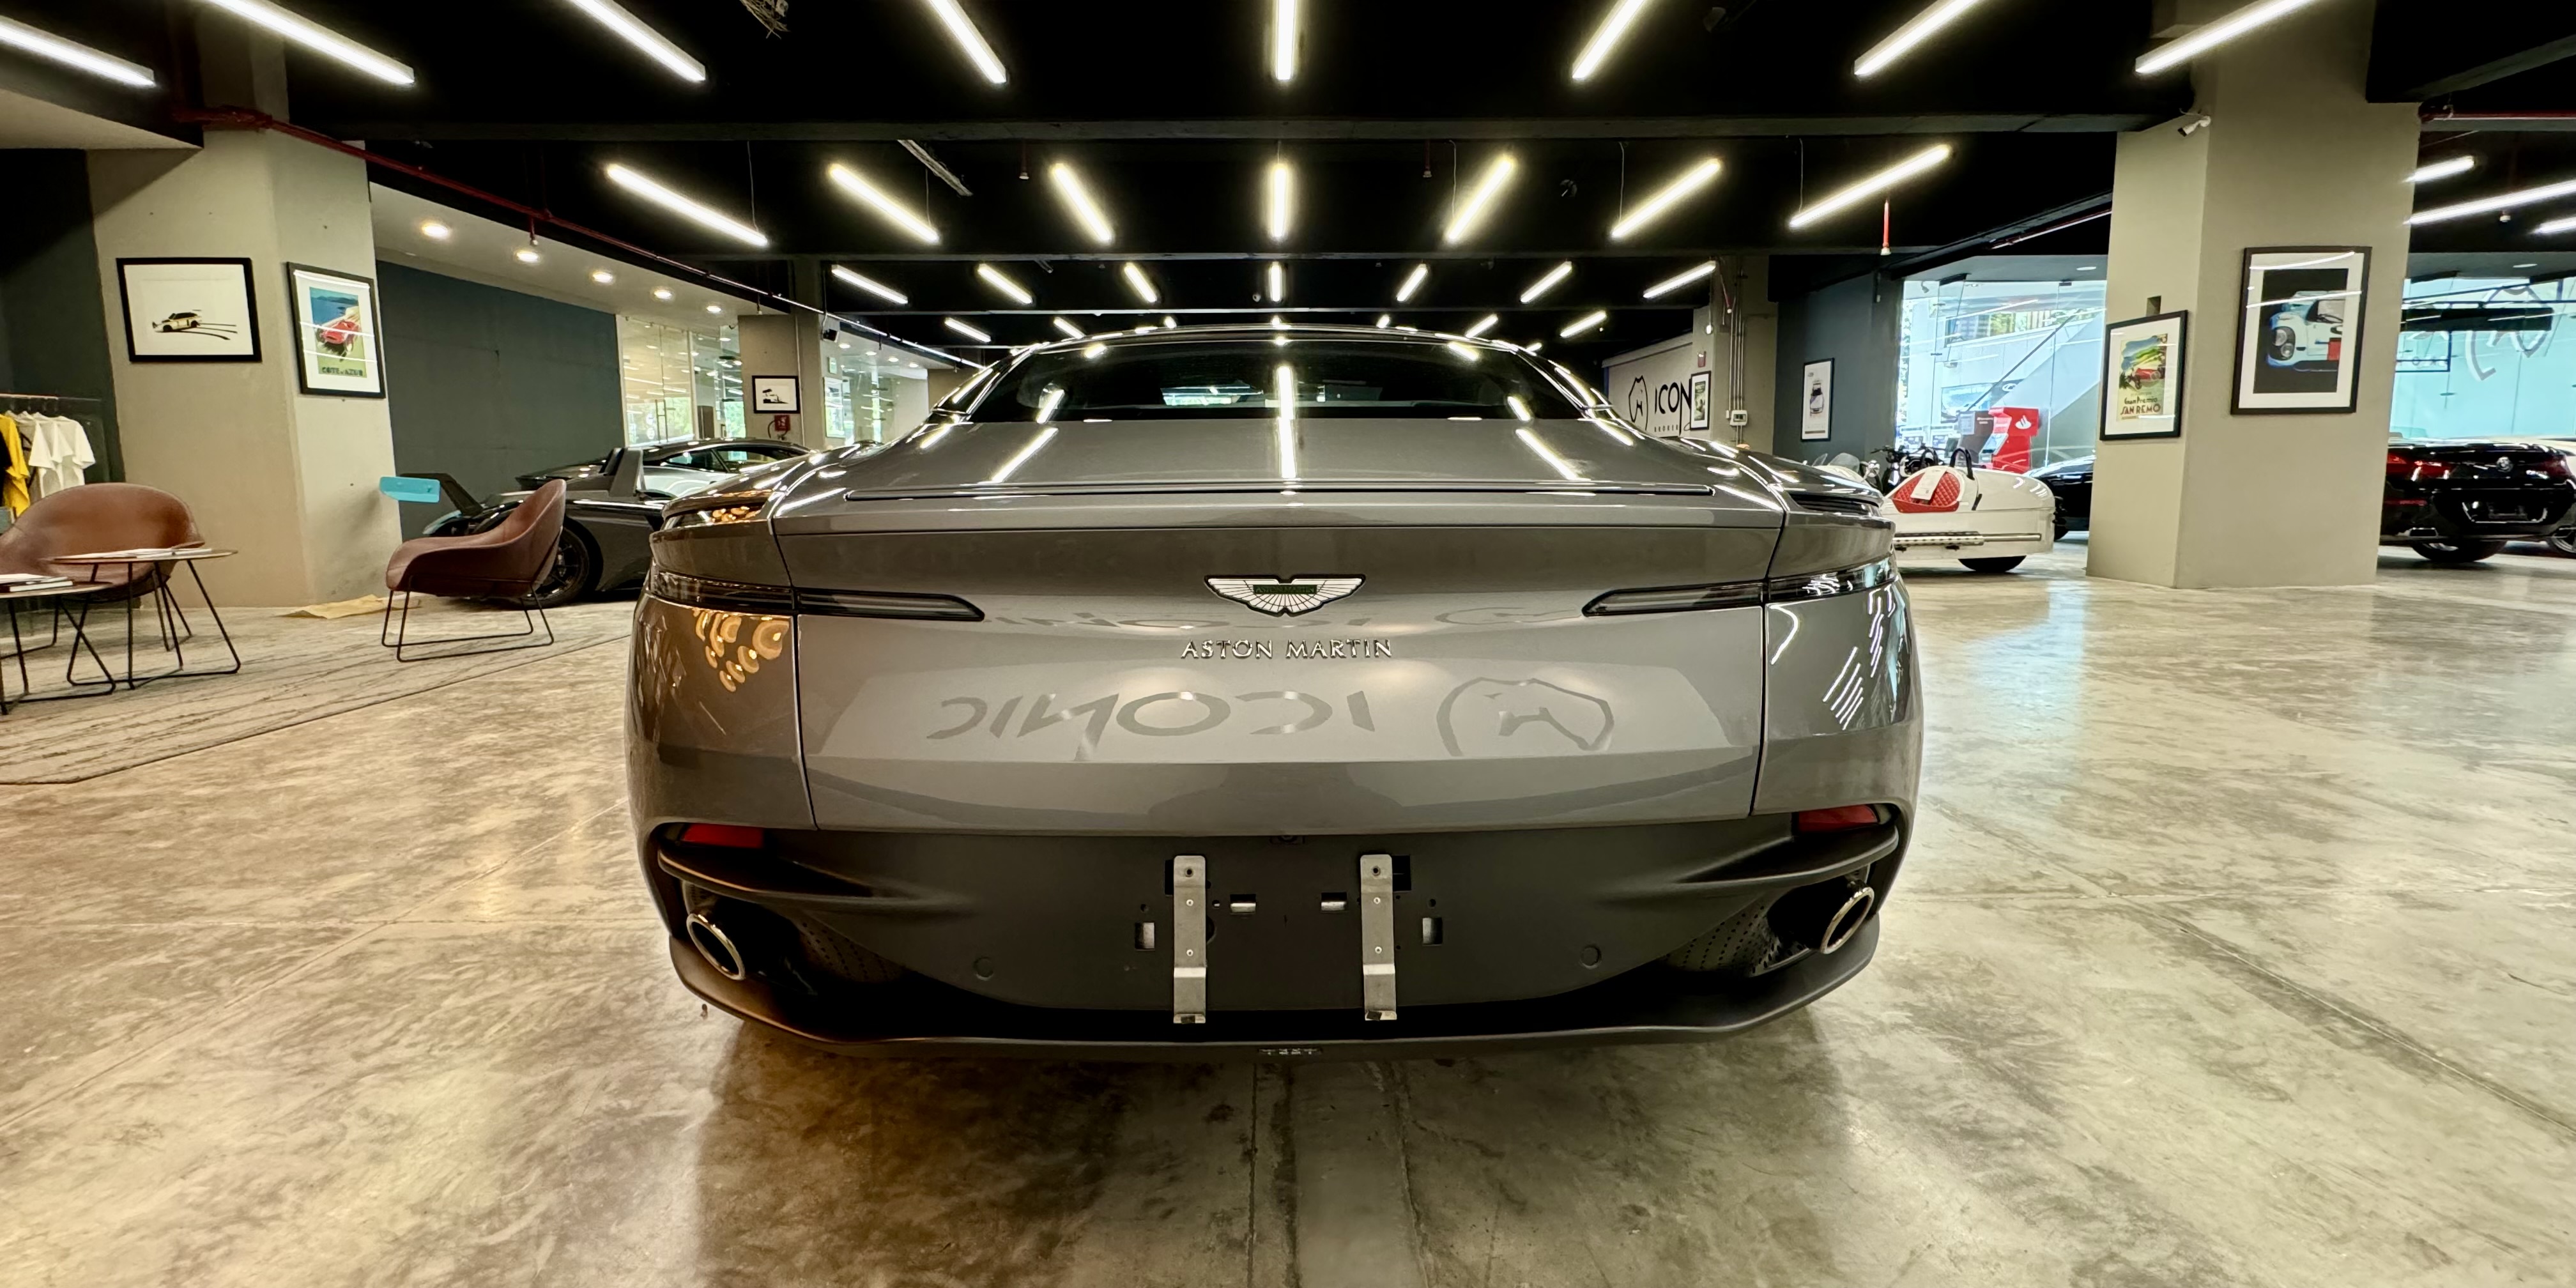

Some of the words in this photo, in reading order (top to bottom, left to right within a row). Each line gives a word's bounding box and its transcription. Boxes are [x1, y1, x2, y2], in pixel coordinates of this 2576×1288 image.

[2120, 406, 2135, 415] SAN
[2136, 403, 2161, 415] REMO
[1181, 640, 1273, 659] ASTON
[1285, 639, 1392, 659] MARTIN
